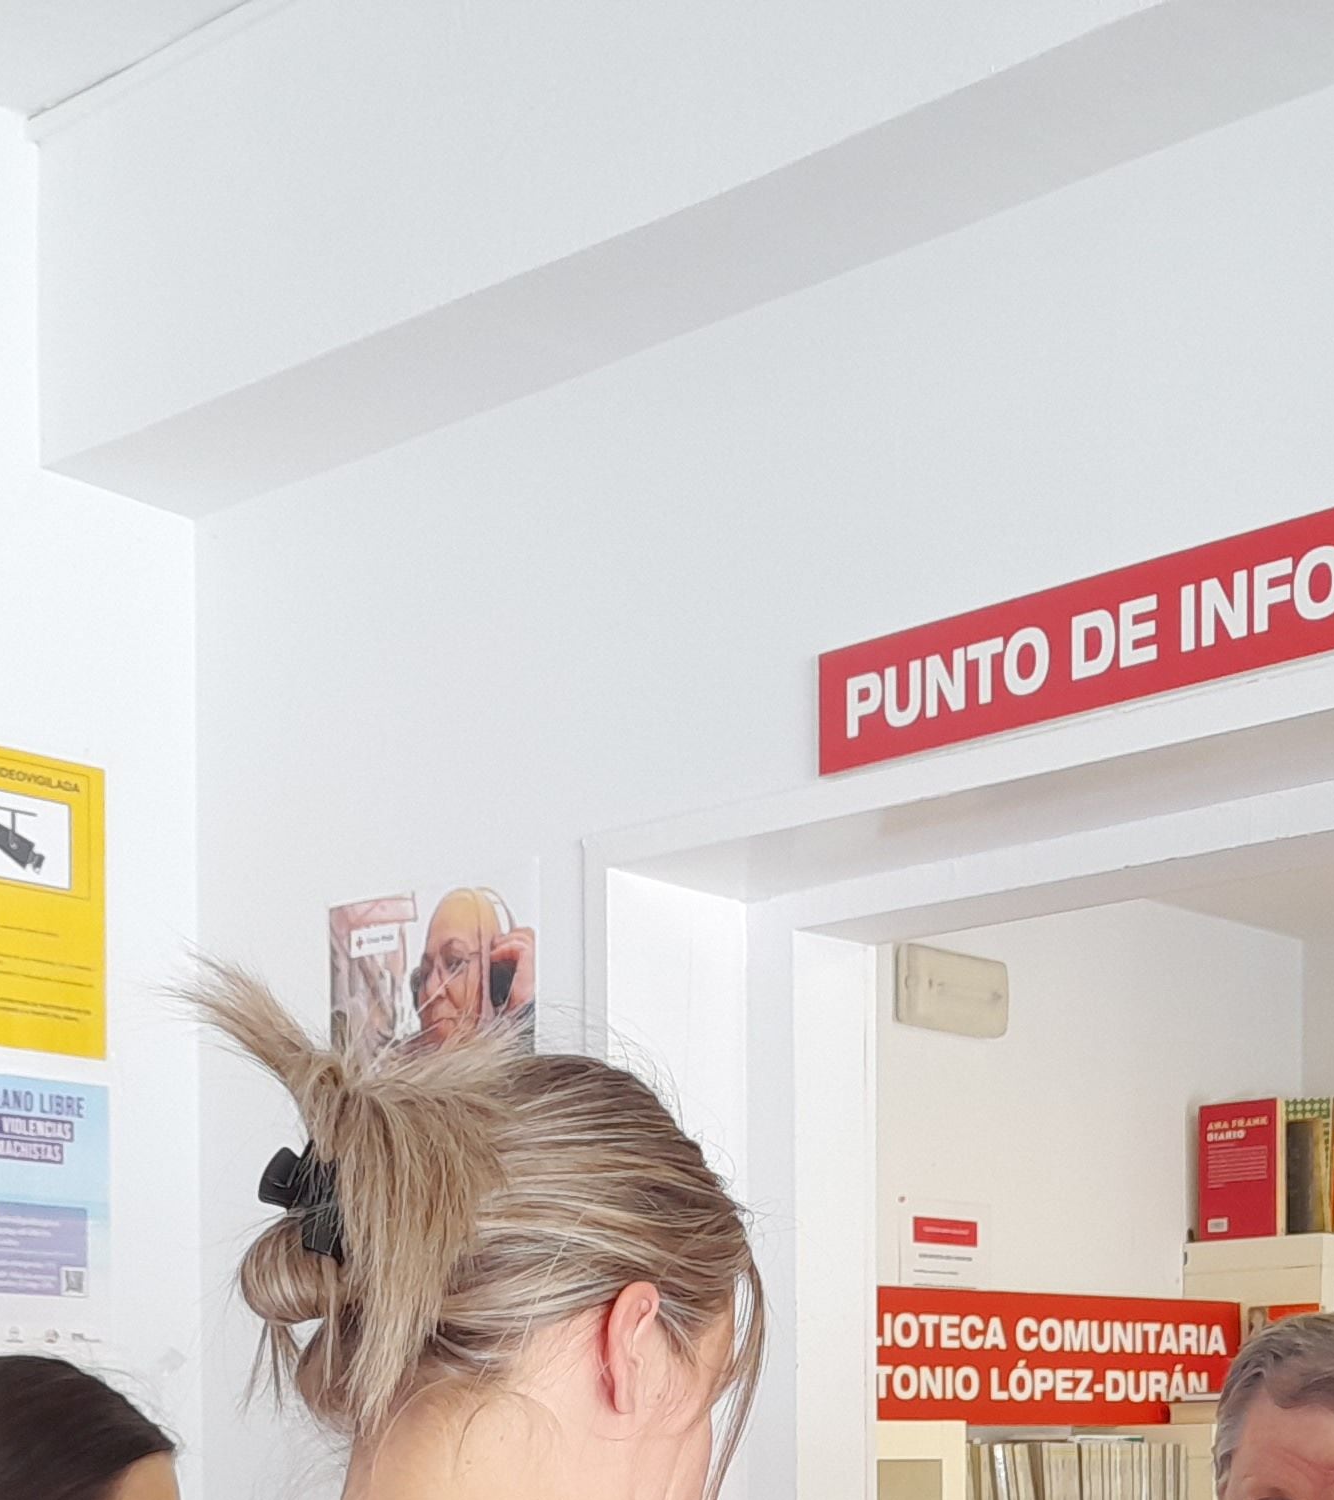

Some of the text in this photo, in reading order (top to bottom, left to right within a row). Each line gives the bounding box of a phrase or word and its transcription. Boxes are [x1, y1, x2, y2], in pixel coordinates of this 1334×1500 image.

[845, 626, 1050, 739] PUNTO
[1070, 595, 1157, 681] DE
[39, 1093, 85, 1119] LIBRE
[2, 1115, 72, 1140] VIOLENCIAS
[1231, 1115, 1269, 1128] FRANK
[1206, 1129, 1246, 1142] DIARIO
[877, 1312, 1227, 1356] IOTECA COMUNITARIA
[990, 1359, 1209, 1403] LÓPEZ-DURÁN
